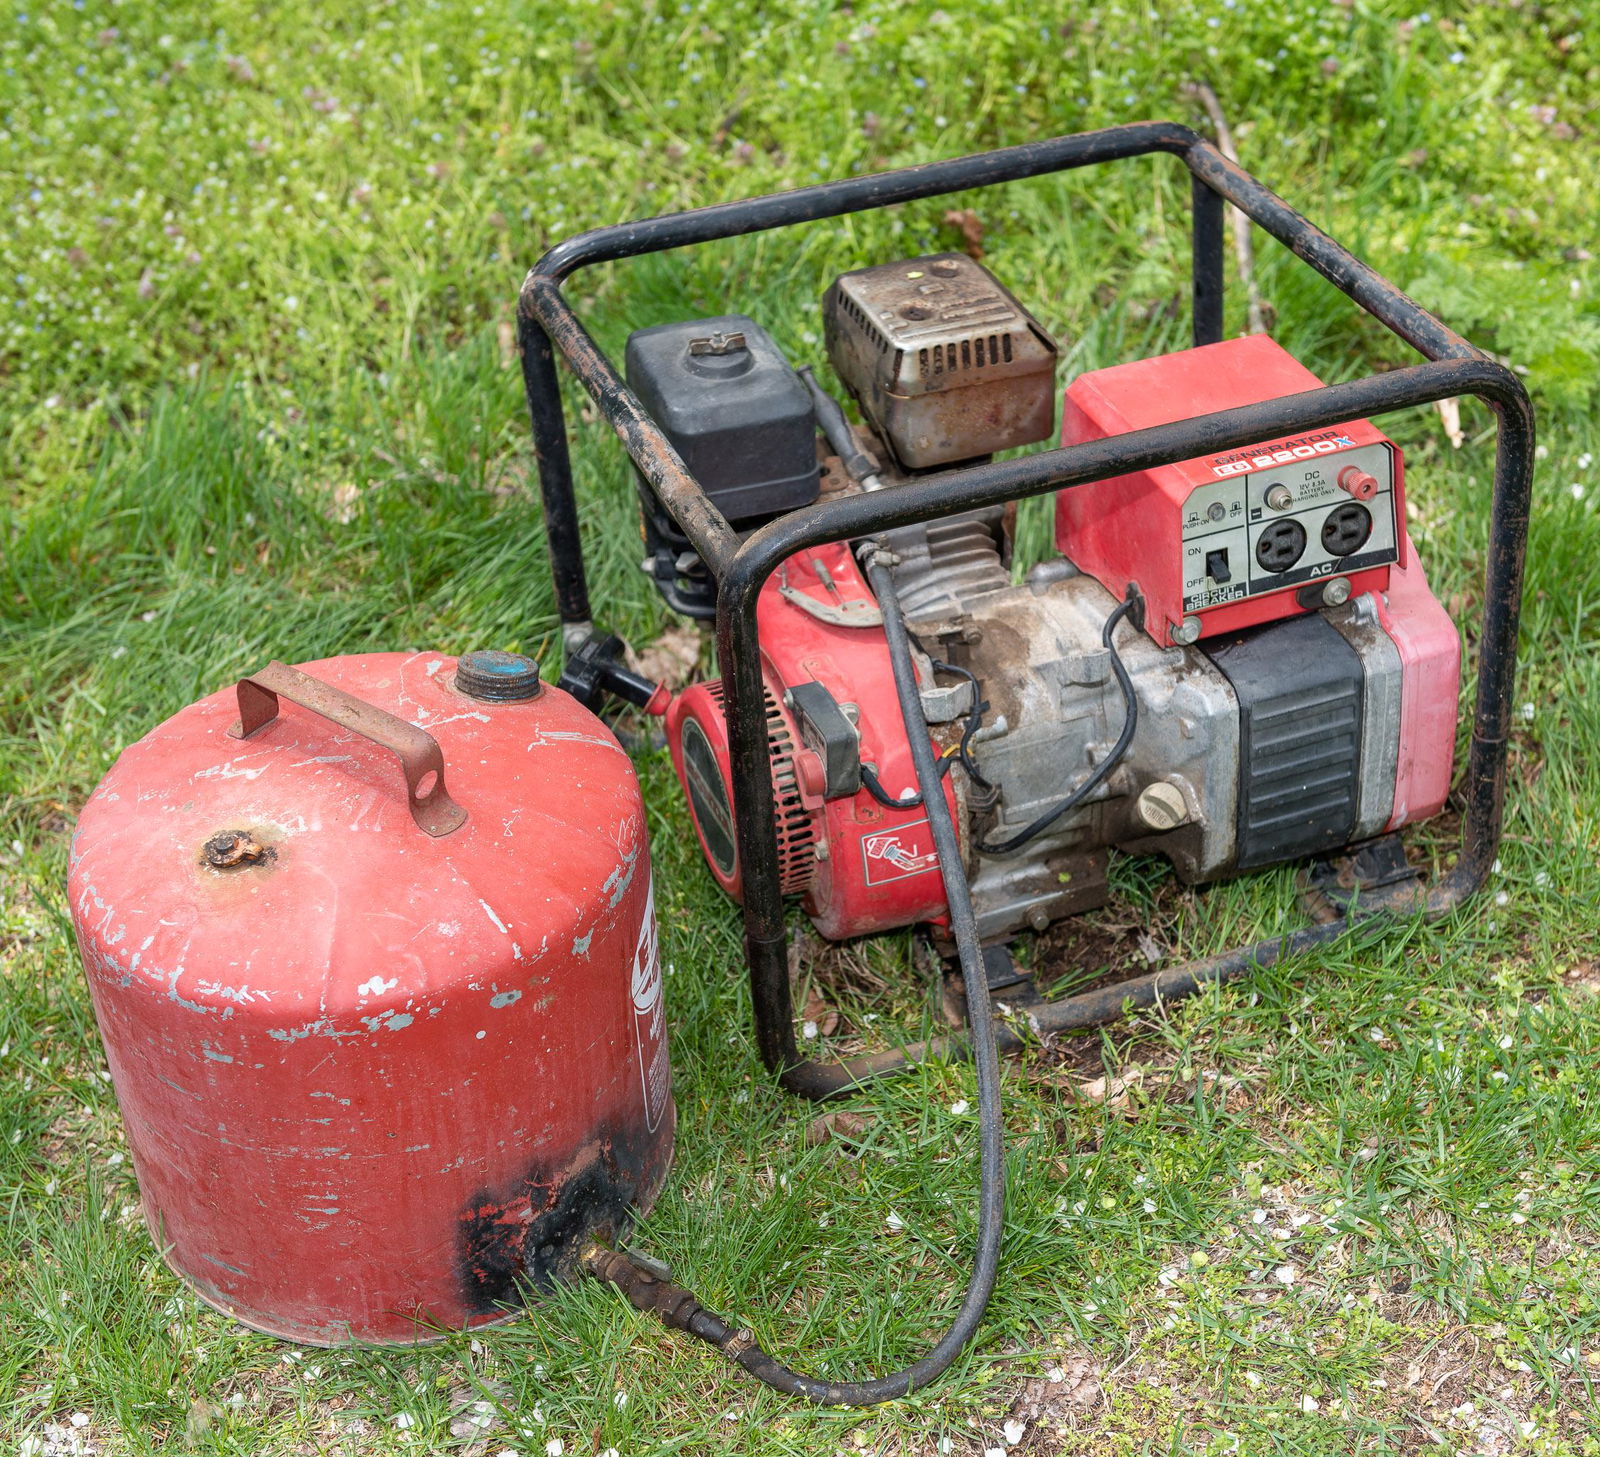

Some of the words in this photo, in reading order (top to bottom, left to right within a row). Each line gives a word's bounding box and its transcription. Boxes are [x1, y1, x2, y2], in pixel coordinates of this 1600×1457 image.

[1215, 431, 1338, 464] GENERATOR
[1215, 462, 1250, 475] EG
[1304, 470, 1320, 480] DC
[1292, 493, 1318, 502] HARGING
[1320, 488, 1336, 496] ONLY
[1300, 486, 1324, 495] BATTERY
[1230, 510, 1242, 518] OFF
[1187, 546, 1201, 556] ON
[1310, 563, 1332, 577] AC
[1186, 577, 1204, 588] OFF
[1190, 584, 1237, 603] CIRCUIT
[1186, 590, 1244, 611] BREAKER
